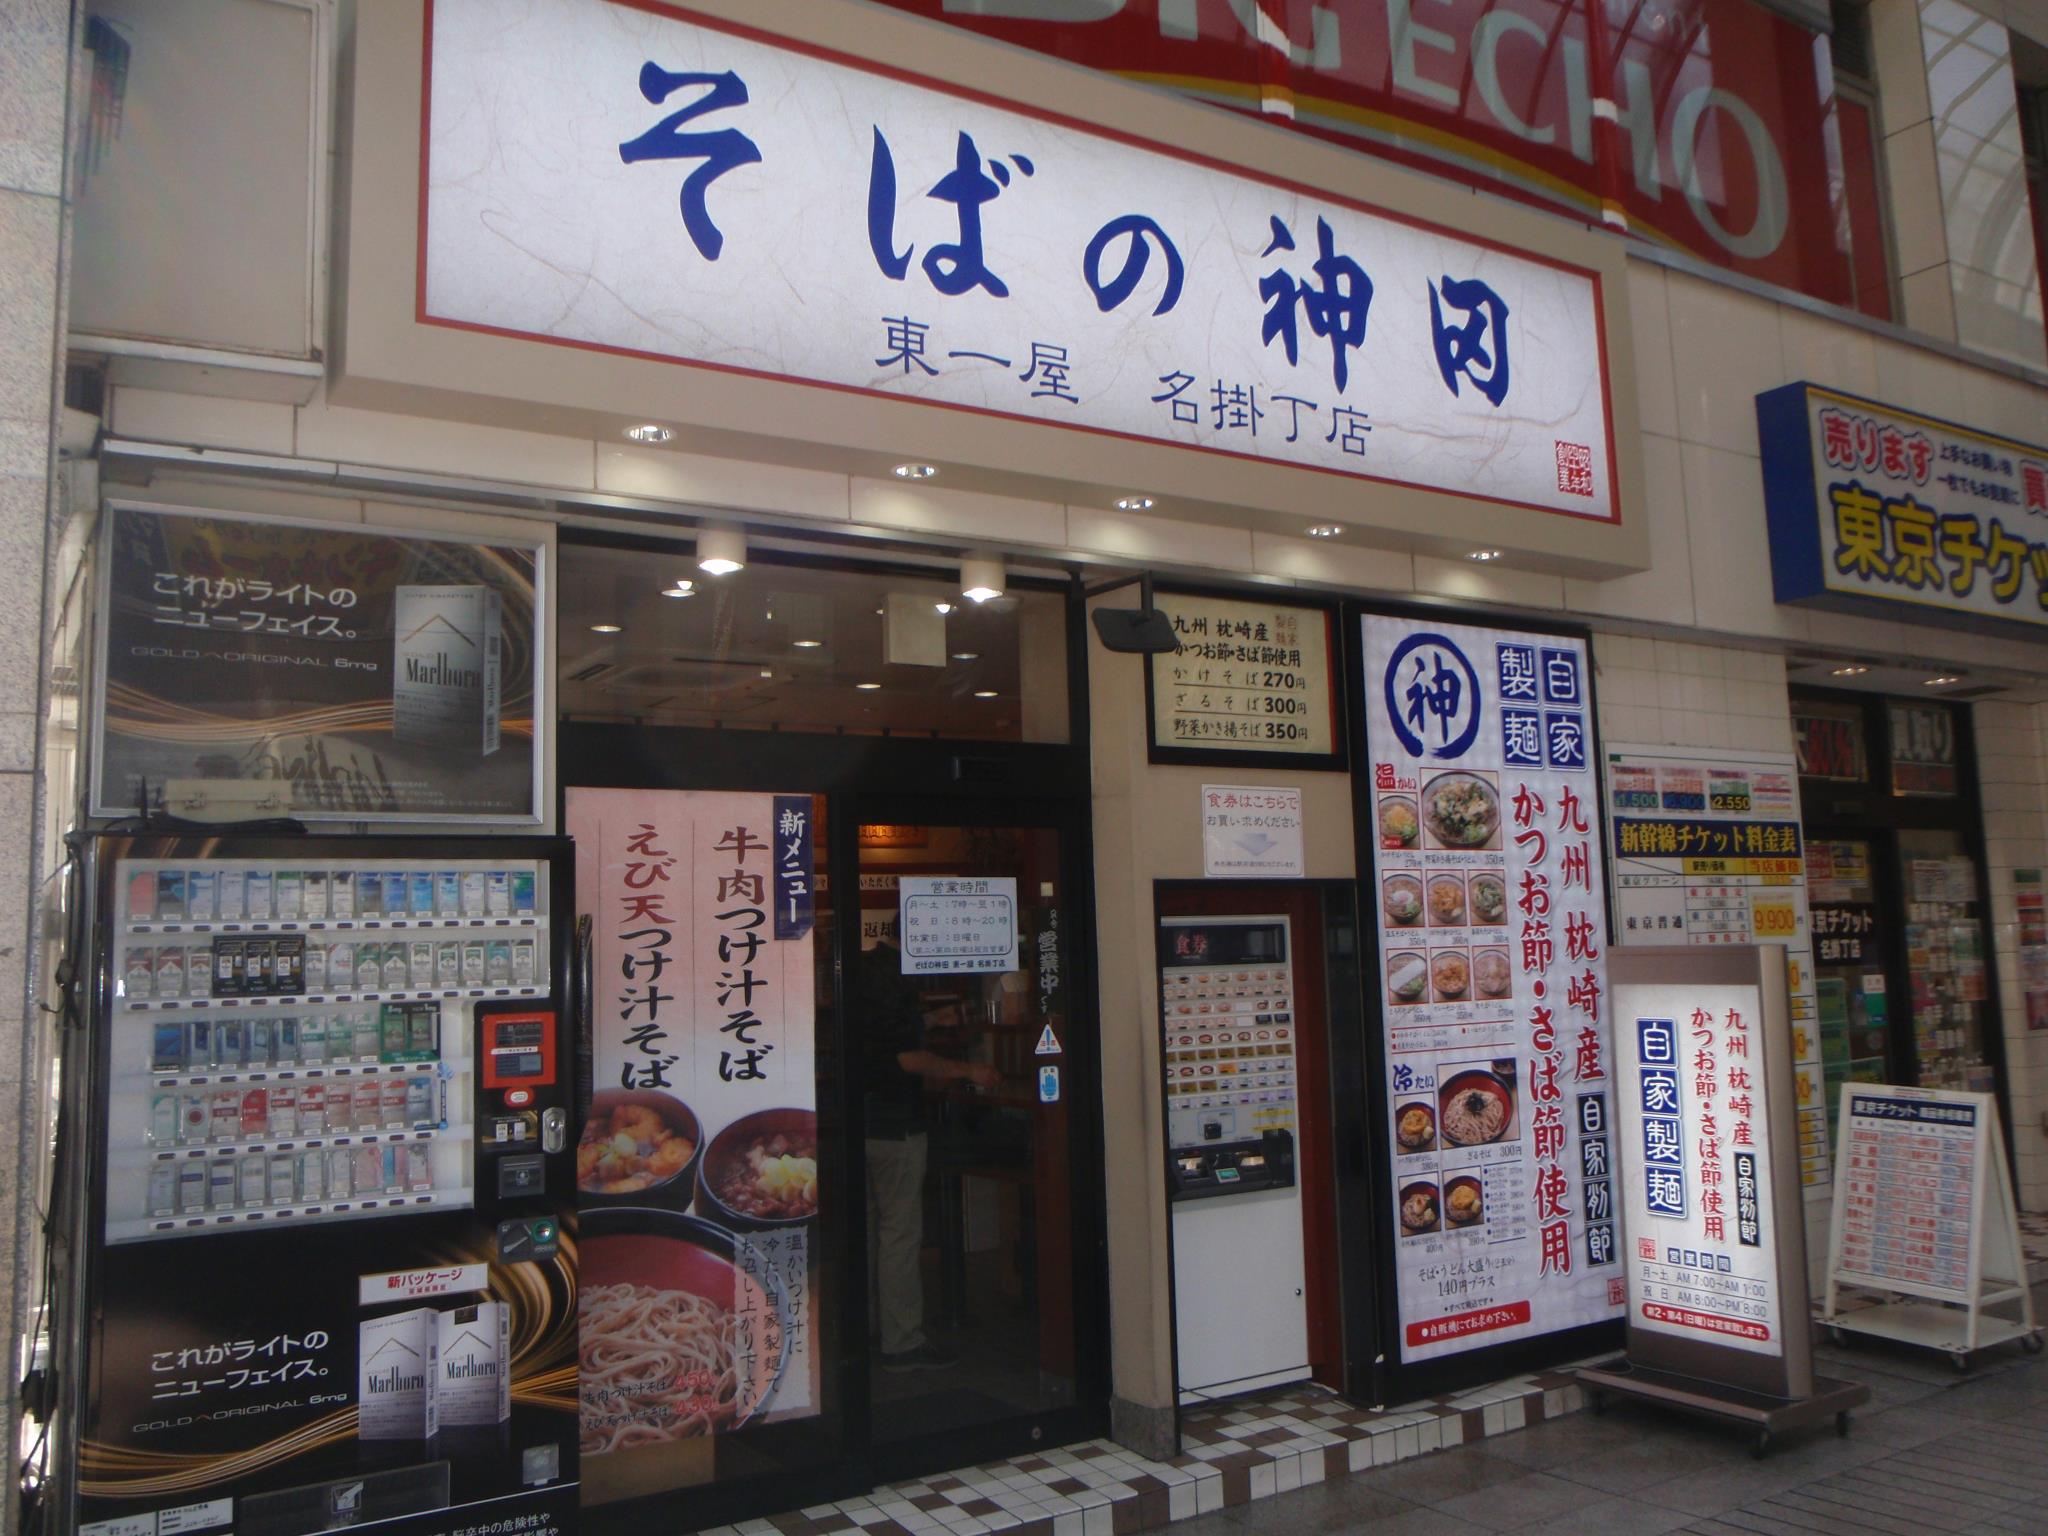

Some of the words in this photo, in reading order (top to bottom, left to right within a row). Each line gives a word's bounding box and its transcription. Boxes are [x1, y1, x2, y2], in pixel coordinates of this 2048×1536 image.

[1391, 0, 1790, 259] ECHO
[619, 61, 1509, 407] そばの神田
[875, 315, 1080, 405] 東一屋
[1151, 370, 1373, 456] 名掛丁店
[1822, 411, 1933, 483] 売ります
[153, 572, 358, 609] これがライトの
[153, 605, 358, 639] ニューフェイス。
[1174, 615, 1208, 637] 九州
[1216, 619, 1270, 642] 枕崎産
[131, 646, 199, 658] GOLD
[223, 650, 328, 668] ORIGINAL
[334, 658, 378, 672] 6mg
[1173, 666, 1259, 686] かけそば
[1263, 671, 1306, 690] 270円
[1174, 693, 1260, 712] ざるそば
[1264, 697, 1307, 715] 300円
[1406, 651, 1462, 745] 神
[1500, 647, 1541, 762] 製麺
[1547, 652, 1584, 764] 自家
[1265, 722, 1308, 741] 350円
[1206, 814, 1301, 828] お買い求めください
[1207, 792, 1300, 810] 食券はこちらで
[1556, 784, 1591, 894] 九州
[1620, 822, 1796, 854] 新幹線チケット料金表
[779, 808, 808, 923] 新メニュー
[930, 880, 989, 895] 営業時間
[619, 824, 680, 1090] えび天つけ汁そば
[712, 826, 774, 1082] 牛肉つけ汁そば
[1038, 930, 1059, 994] 営業中
[1563, 910, 1606, 1082] 枕崎産
[1511, 782, 1572, 1278] かつお節・さば節使用
[1724, 1007, 1748, 1059] 九州
[1393, 1064, 1434, 1092] 冷たい
[1643, 1022, 1683, 1213] 自家製麺
[1691, 1006, 1726, 1242] かつお節・さば節使用
[1728, 1066, 1754, 1147] 枕崎産
[1500, 1144, 1523, 1158] 300円
[387, 1268, 463, 1289] 新パッケージ
[1668, 1248, 1731, 1272] 営業時間
[785, 1234, 805, 1354] 温かいつけ汁に
[1437, 1275, 1496, 1297] 140円プラス
[1676, 1272, 1691, 1284] AM
[1743, 1283, 1766, 1297] 1:00
[1677, 1290, 1692, 1303] AM
[1743, 1304, 1767, 1318] 8:00
[151, 1330, 329, 1374] これがライトの
[446, 1353, 497, 1380] Marlboro
[152, 1358, 329, 1401] ニューフェイス。
[368, 1365, 424, 1395] Marlboro
[133, 1415, 193, 1433] GOLD
[208, 1399, 304, 1422] ORIGINAL
[309, 1393, 348, 1406] 6mg
